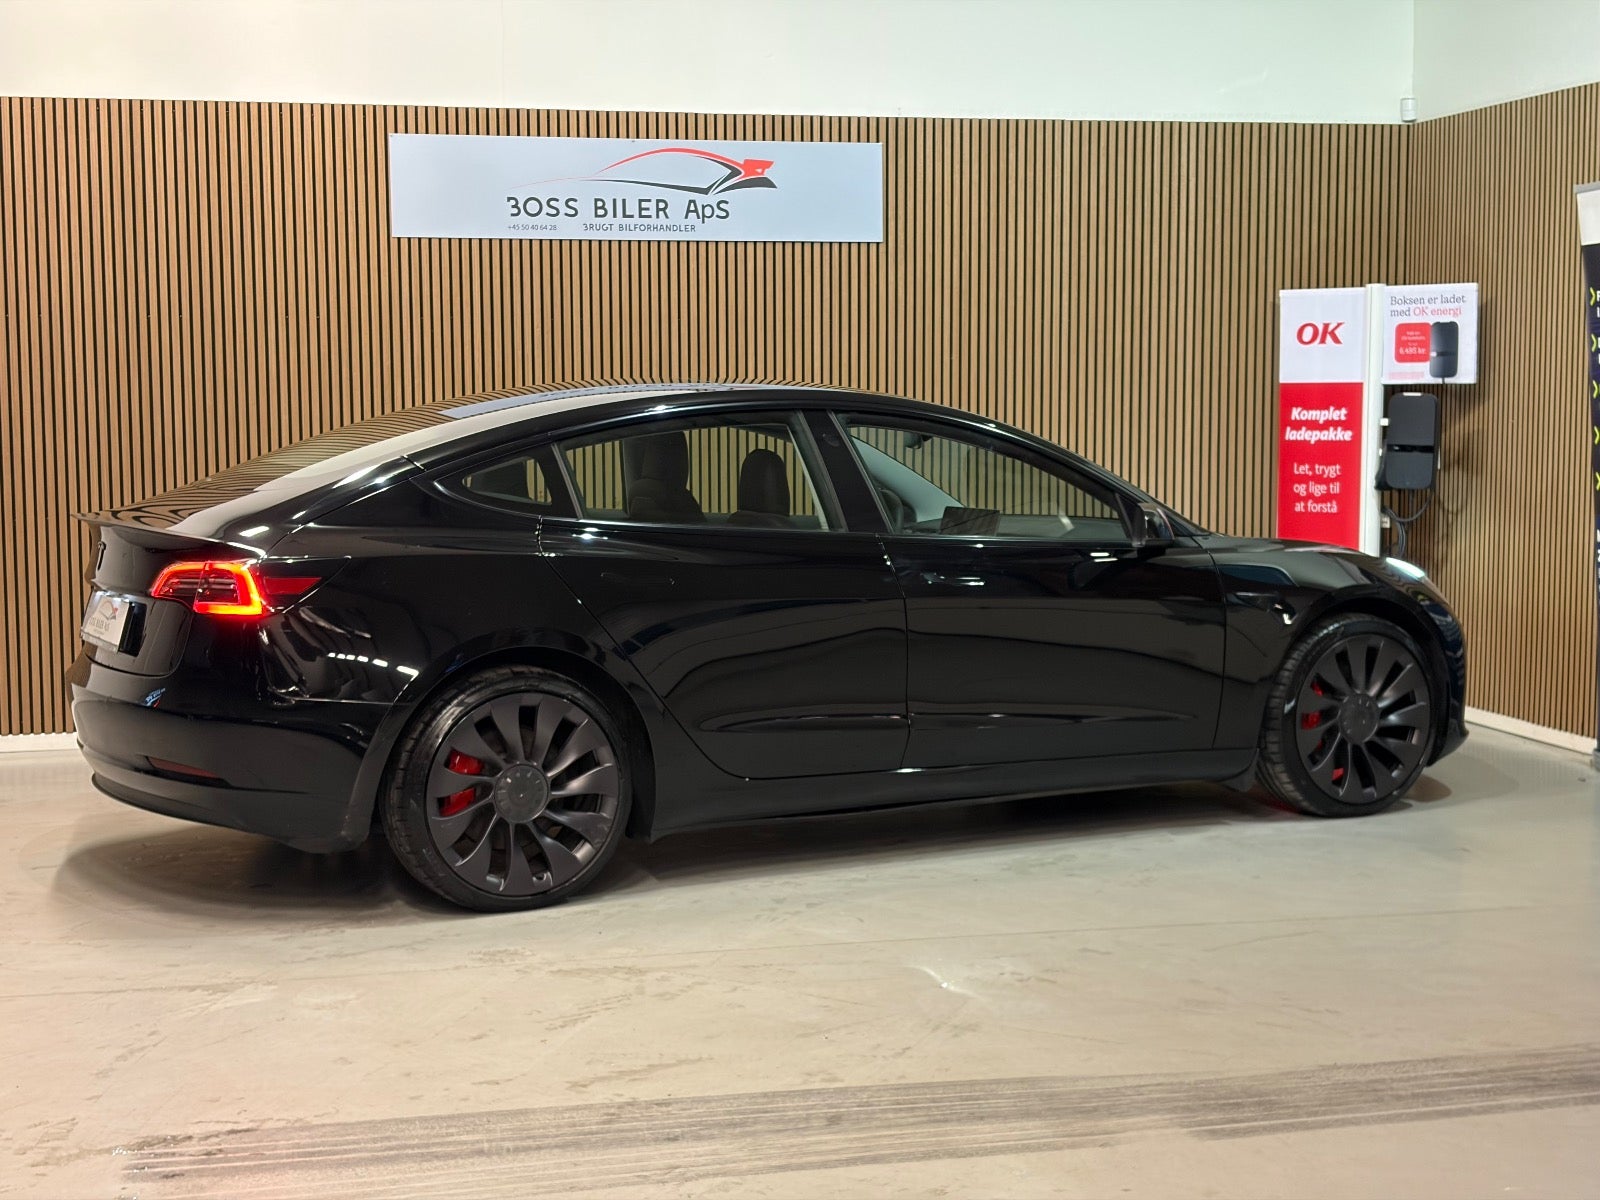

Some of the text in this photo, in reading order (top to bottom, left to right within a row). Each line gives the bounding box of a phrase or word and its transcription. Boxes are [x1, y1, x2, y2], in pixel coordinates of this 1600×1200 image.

[594, 198, 669, 219] BILER
[684, 199, 730, 224] ApS
[618, 223, 696, 232] BILFORHANDLER
[1390, 293, 1466, 306] Boksen er ladet
[1390, 306, 1462, 318] med OK energi
[1296, 322, 1345, 346] OK
[1291, 406, 1347, 424] Komplet
[1285, 426, 1353, 444] ladepakke
[1293, 463, 1341, 478] Let, trygt
[1293, 481, 1340, 497] og lige til
[1294, 500, 1338, 513] at forstå
